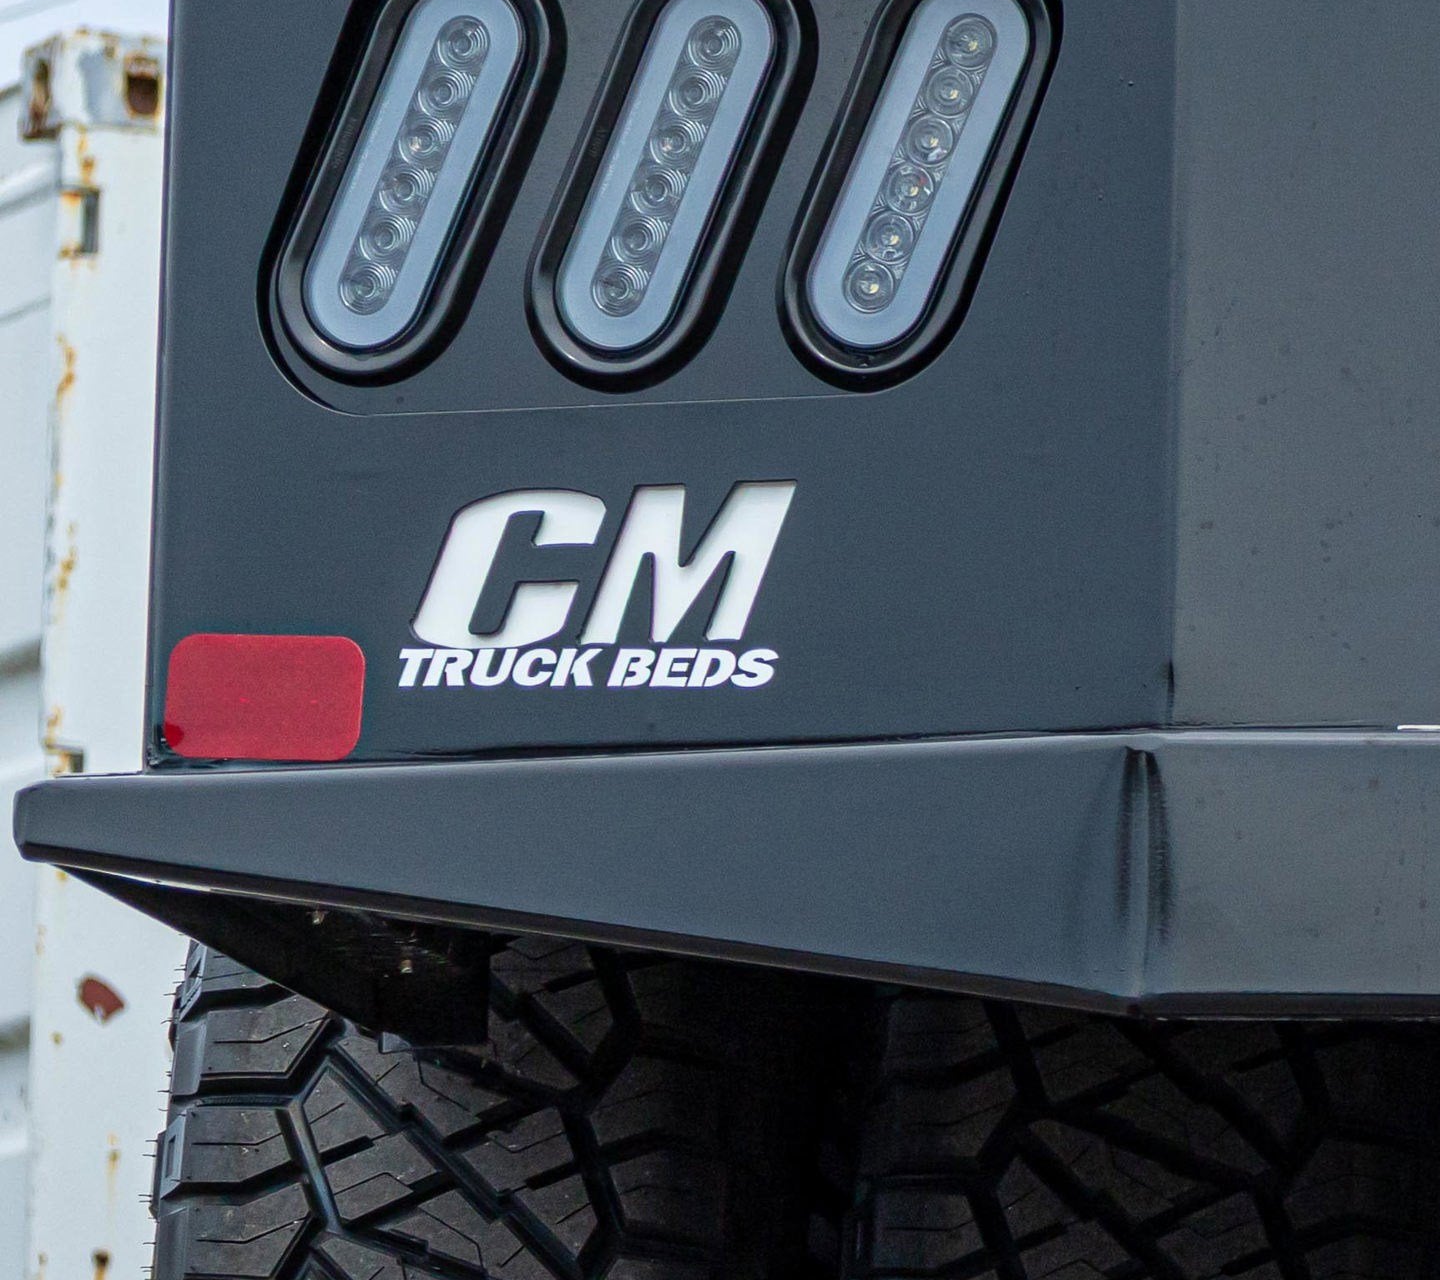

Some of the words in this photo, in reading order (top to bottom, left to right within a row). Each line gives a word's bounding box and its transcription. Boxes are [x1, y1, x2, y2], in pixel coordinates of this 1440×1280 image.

[409, 478, 798, 649] CM
[398, 647, 604, 688] TRUCK
[606, 647, 779, 688] BEDS
